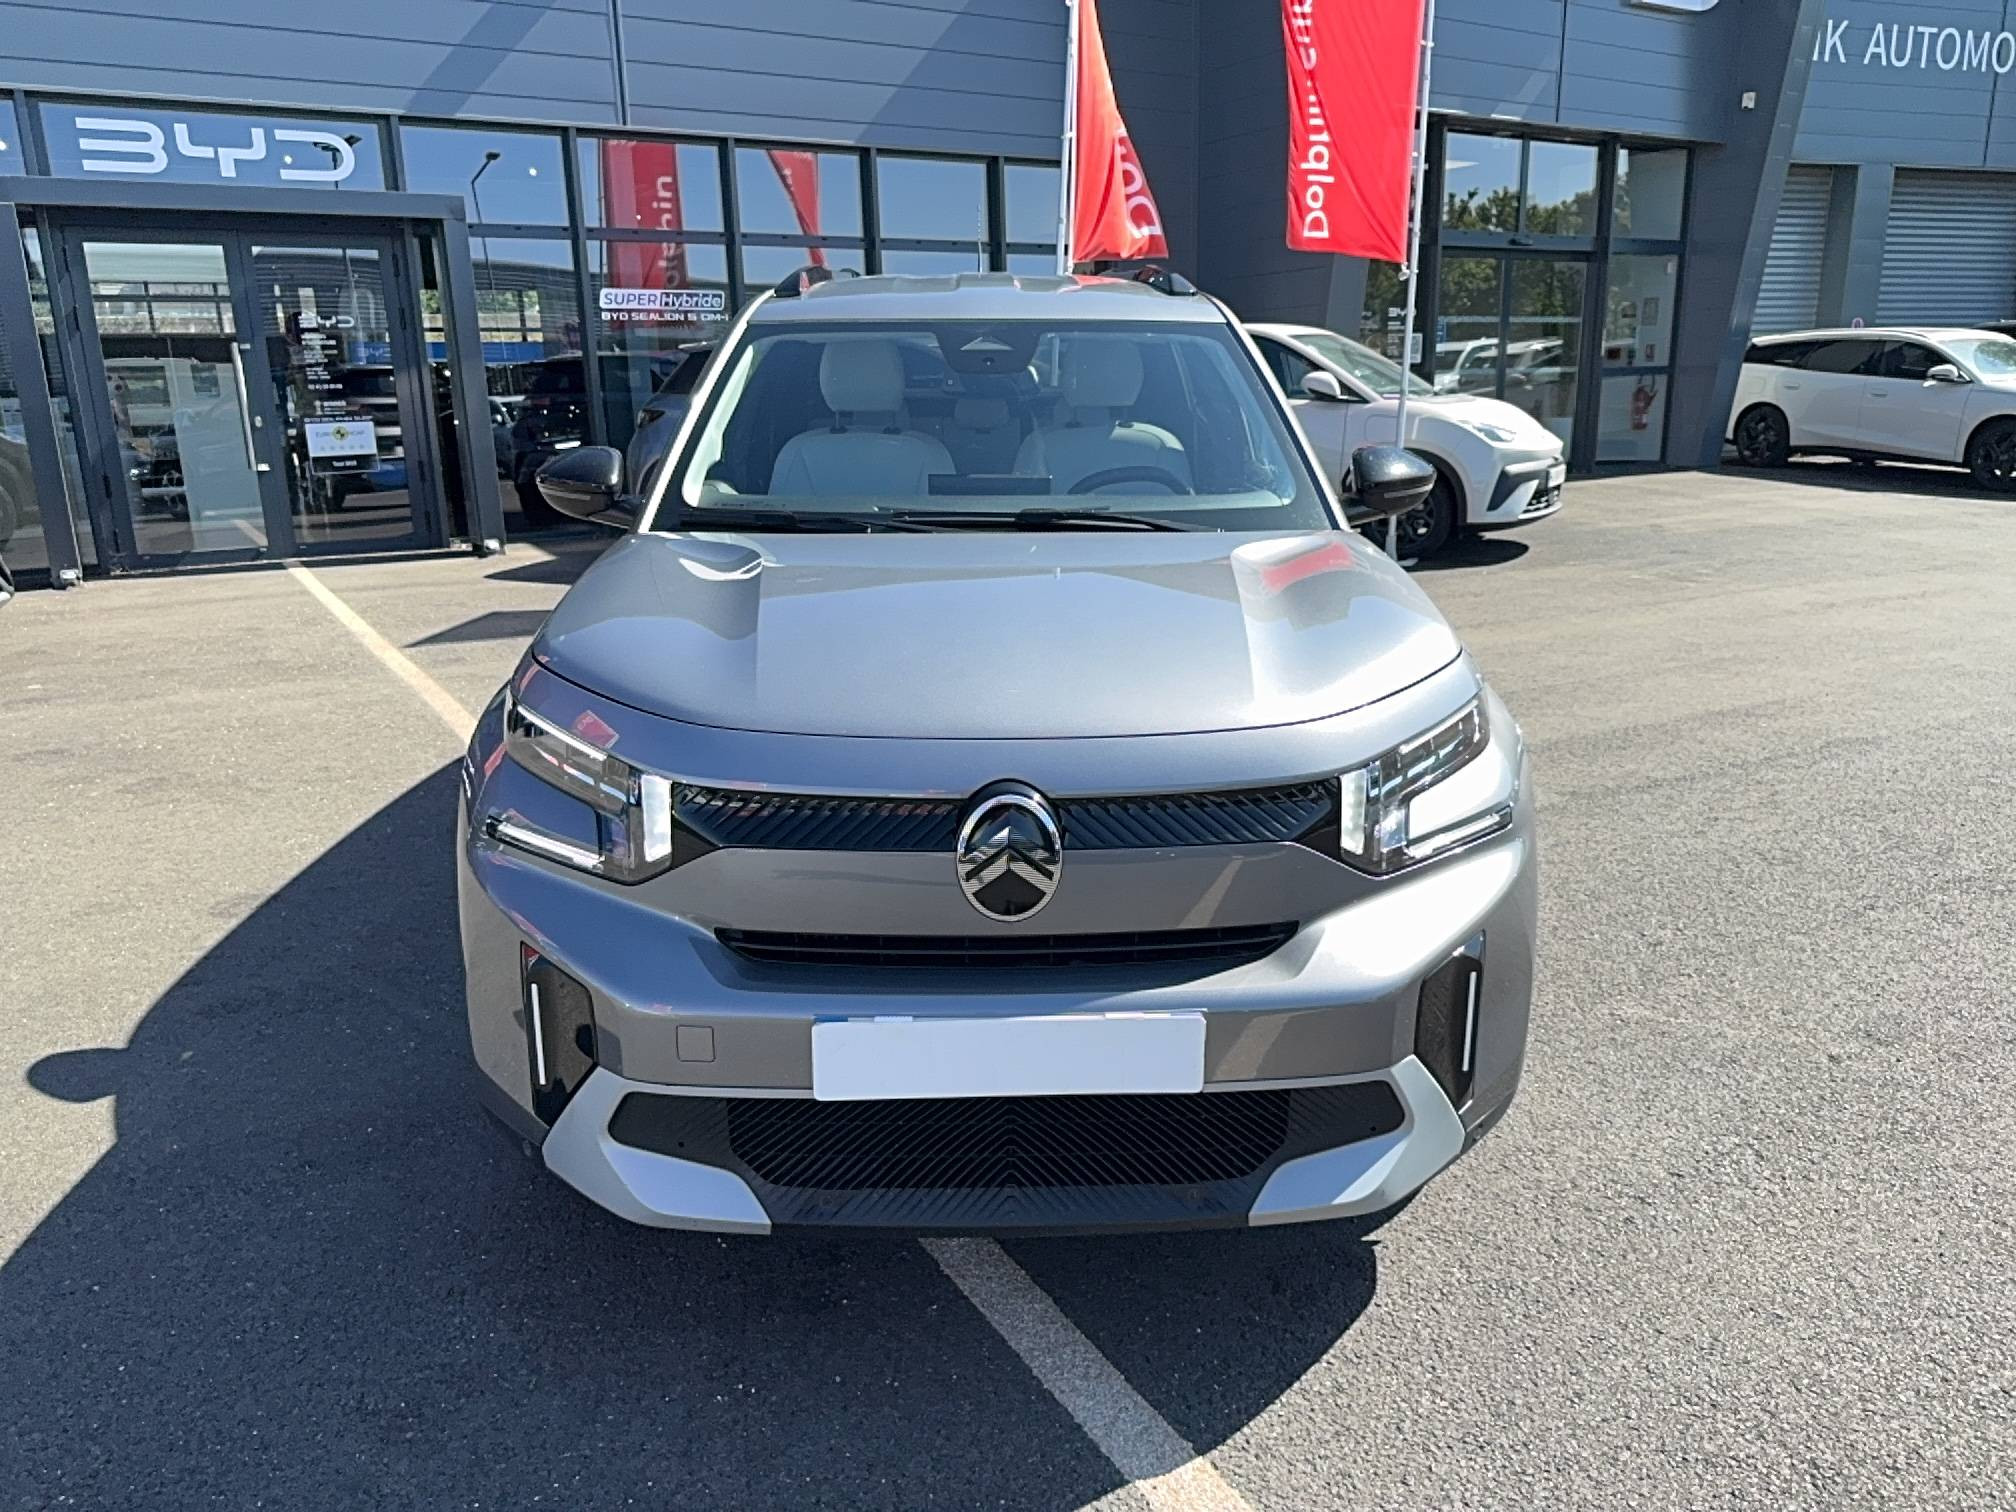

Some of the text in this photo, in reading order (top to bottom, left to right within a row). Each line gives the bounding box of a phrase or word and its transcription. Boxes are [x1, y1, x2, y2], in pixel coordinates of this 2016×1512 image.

[1863, 23, 2015, 73] AUTOMO
[75, 117, 355, 181] BYD
[601, 311, 629, 321] BYD
[604, 292, 721, 311] SUPER Hybride
